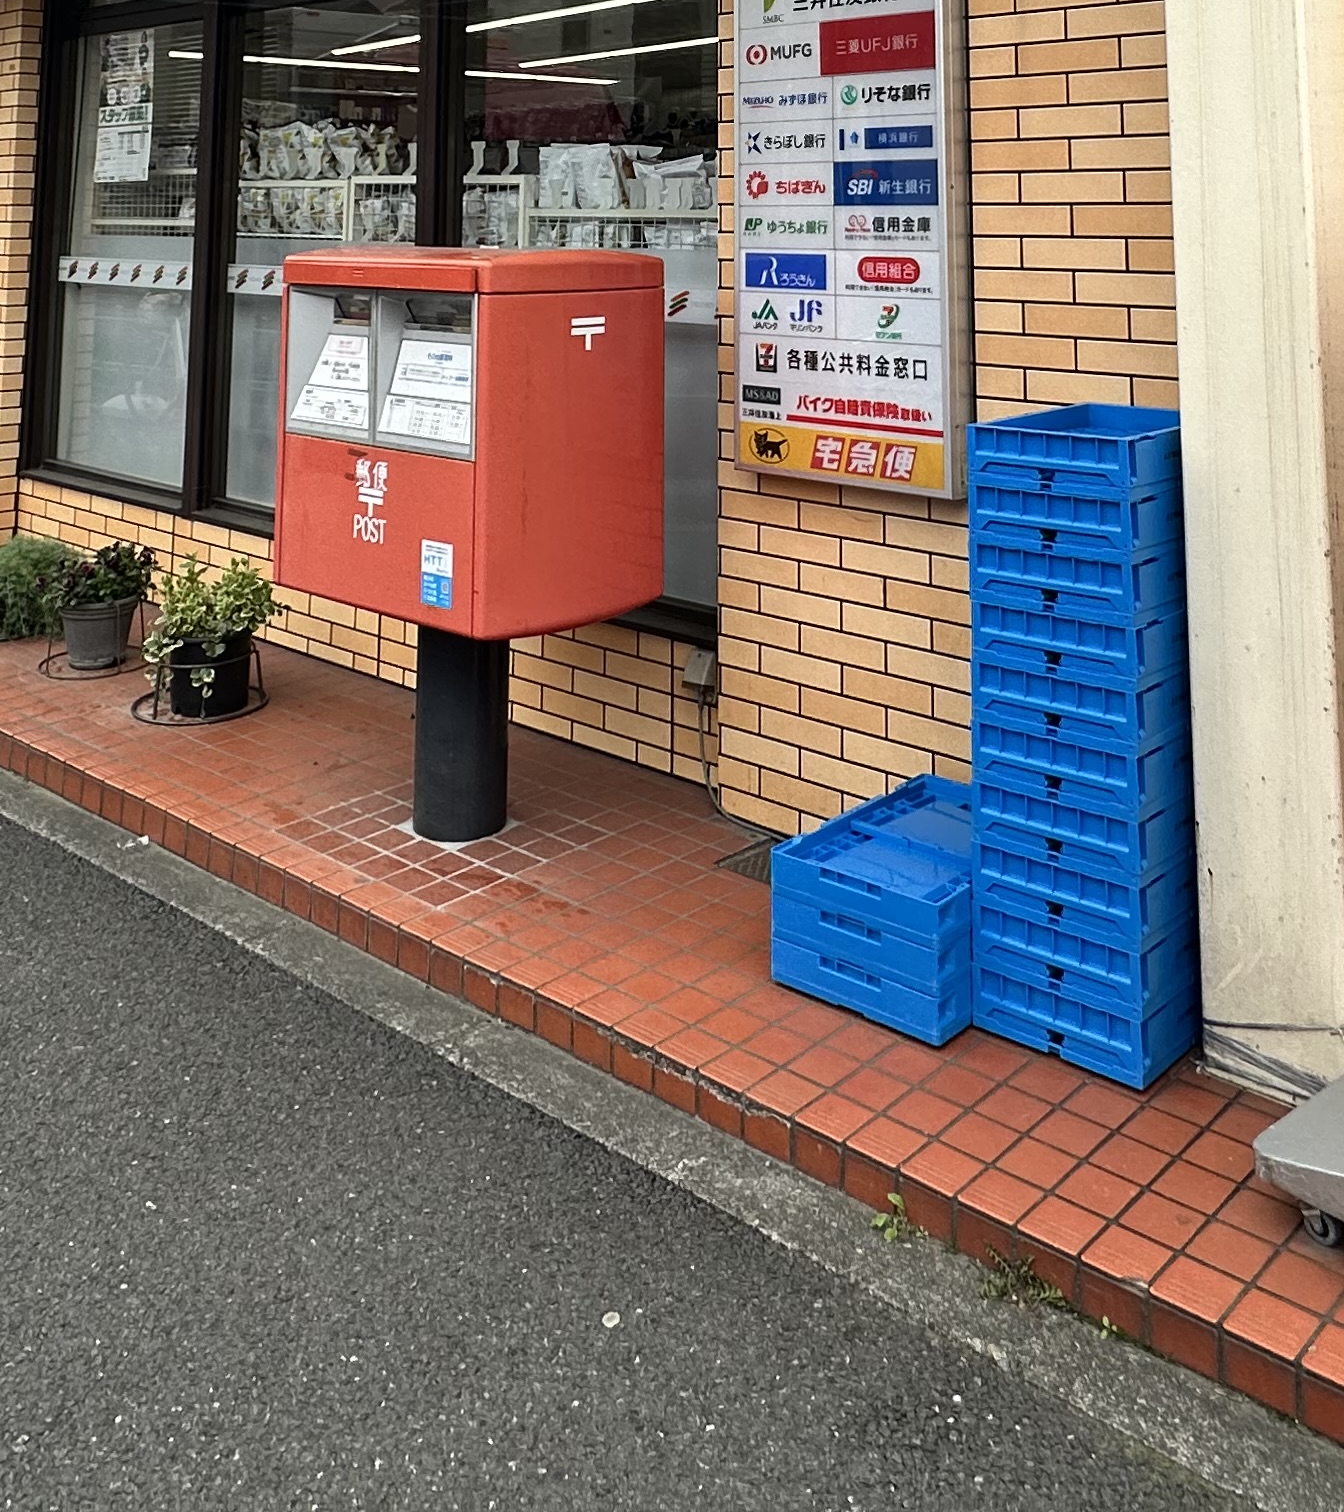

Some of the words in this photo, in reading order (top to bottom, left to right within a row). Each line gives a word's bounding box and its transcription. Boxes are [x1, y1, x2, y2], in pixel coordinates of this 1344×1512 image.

[762, 13, 785, 25] SMBC
[770, 43, 812, 60] MUFG
[836, 33, 918, 55] 三菱UFJ銀行
[778, 92, 828, 106] みずほ銀行
[861, 83, 931, 104] りそな銀行
[763, 133, 826, 150] きらぼし銀行
[877, 131, 919, 143] 横浜銀行
[774, 180, 826, 195] ちばぎん
[847, 178, 874, 196] SBI
[878, 178, 932, 195] 新生銀行
[766, 220, 828, 235] ゆうちょ銀行
[872, 216, 931, 233] 信用金庫
[862, 261, 917, 280] 信用組合
[779, 273, 816, 287] ろうきん
[787, 348, 928, 381] 各種公共料金窓口
[814, 437, 915, 479] 宅急便
[355, 458, 389, 492] 郵便
[352, 513, 387, 545] POST
